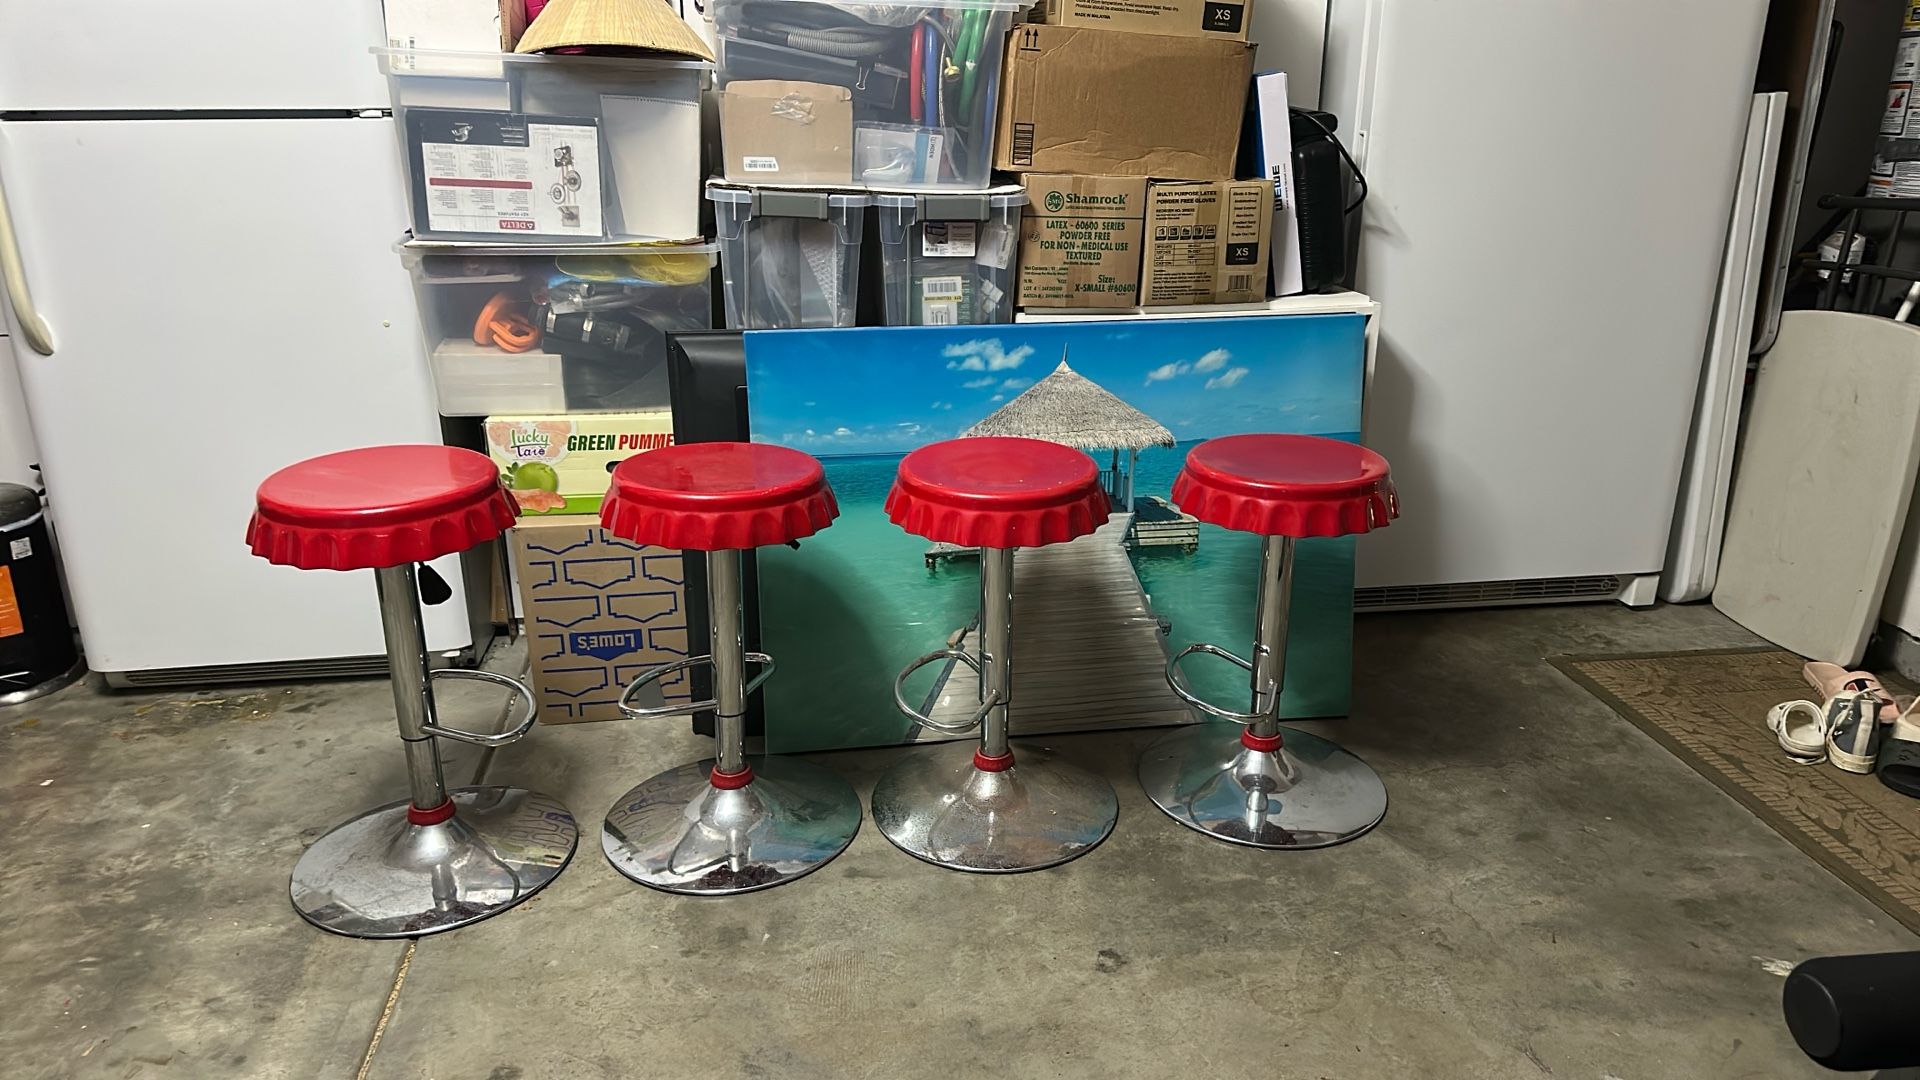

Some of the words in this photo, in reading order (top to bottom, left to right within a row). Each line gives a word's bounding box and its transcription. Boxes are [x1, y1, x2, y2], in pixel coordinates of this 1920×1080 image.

[1214, 8, 1231, 20] XS
[1065, 193, 1126, 205] Shamrock
[501, 221, 526, 229] DELTA
[1046, 220, 1068, 230] LATEX
[1075, 220, 1099, 231] 60600
[1102, 221, 1126, 231] SERIES
[1060, 230, 1093, 241] POWDER
[1094, 231, 1111, 241] FREE
[1040, 240, 1056, 250] FOR
[1056, 240, 1076, 250] NON
[1081, 242, 1114, 252] MEDICAL
[1115, 242, 1129, 252] USE
[1235, 247, 1249, 256] XS
[1066, 251, 1103, 261] TEXTURED
[1098, 274, 1116, 283] Size:
[1074, 283, 1106, 293] X-SMALL
[1107, 283, 1136, 293] #60600
[511, 429, 549, 448] Lucky
[567, 434, 616, 451] GREEN
[618, 433, 674, 450] PUMME
[577, 633, 635, 650] LOWE'S
